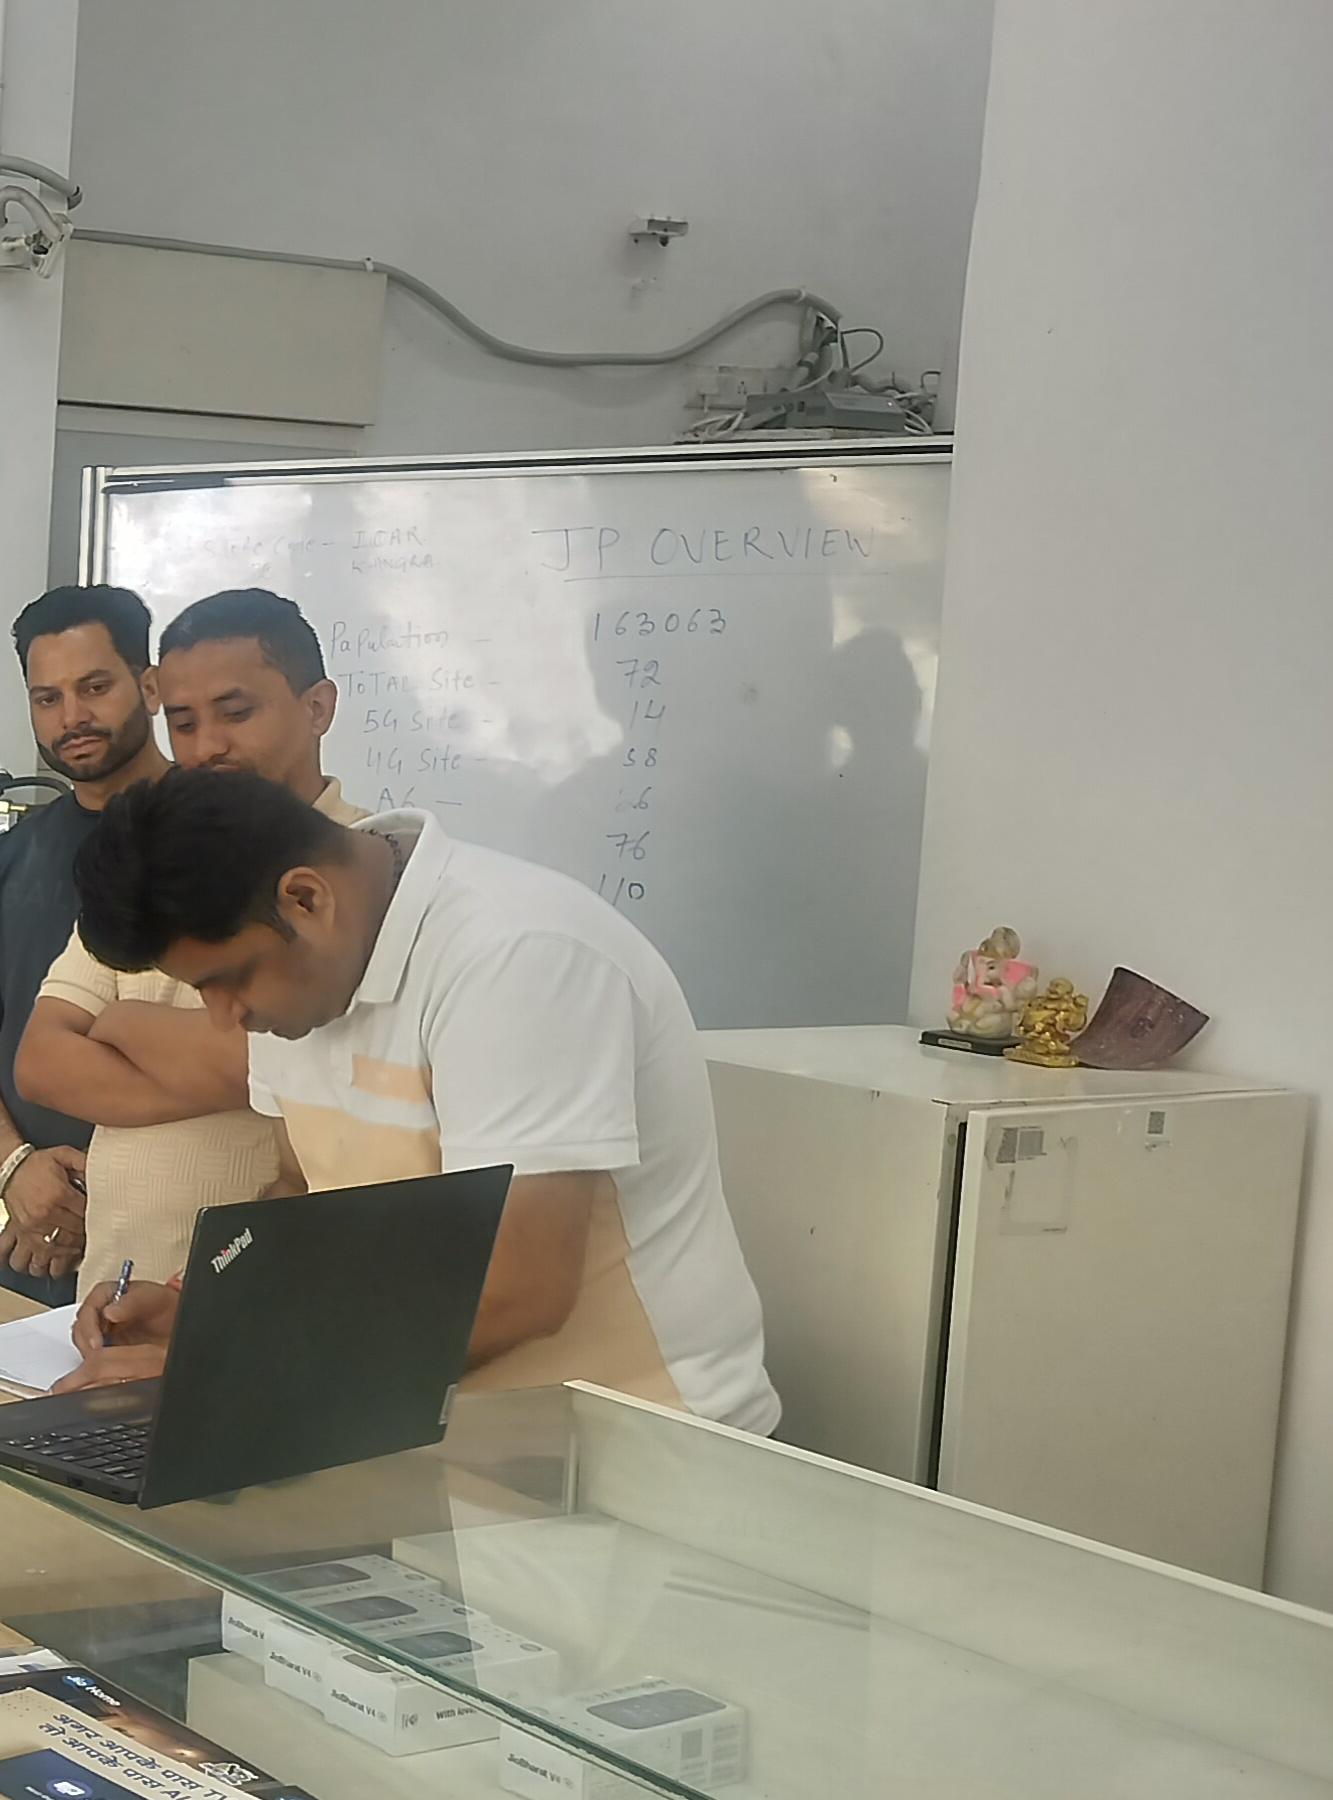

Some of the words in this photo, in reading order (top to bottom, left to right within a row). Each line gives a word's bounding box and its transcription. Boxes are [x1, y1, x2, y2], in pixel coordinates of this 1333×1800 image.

[651, 527, 874, 565] OVERVIEW
[595, 608, 726, 641] 163063
[210, 1227, 253, 1274] ThinkPad
